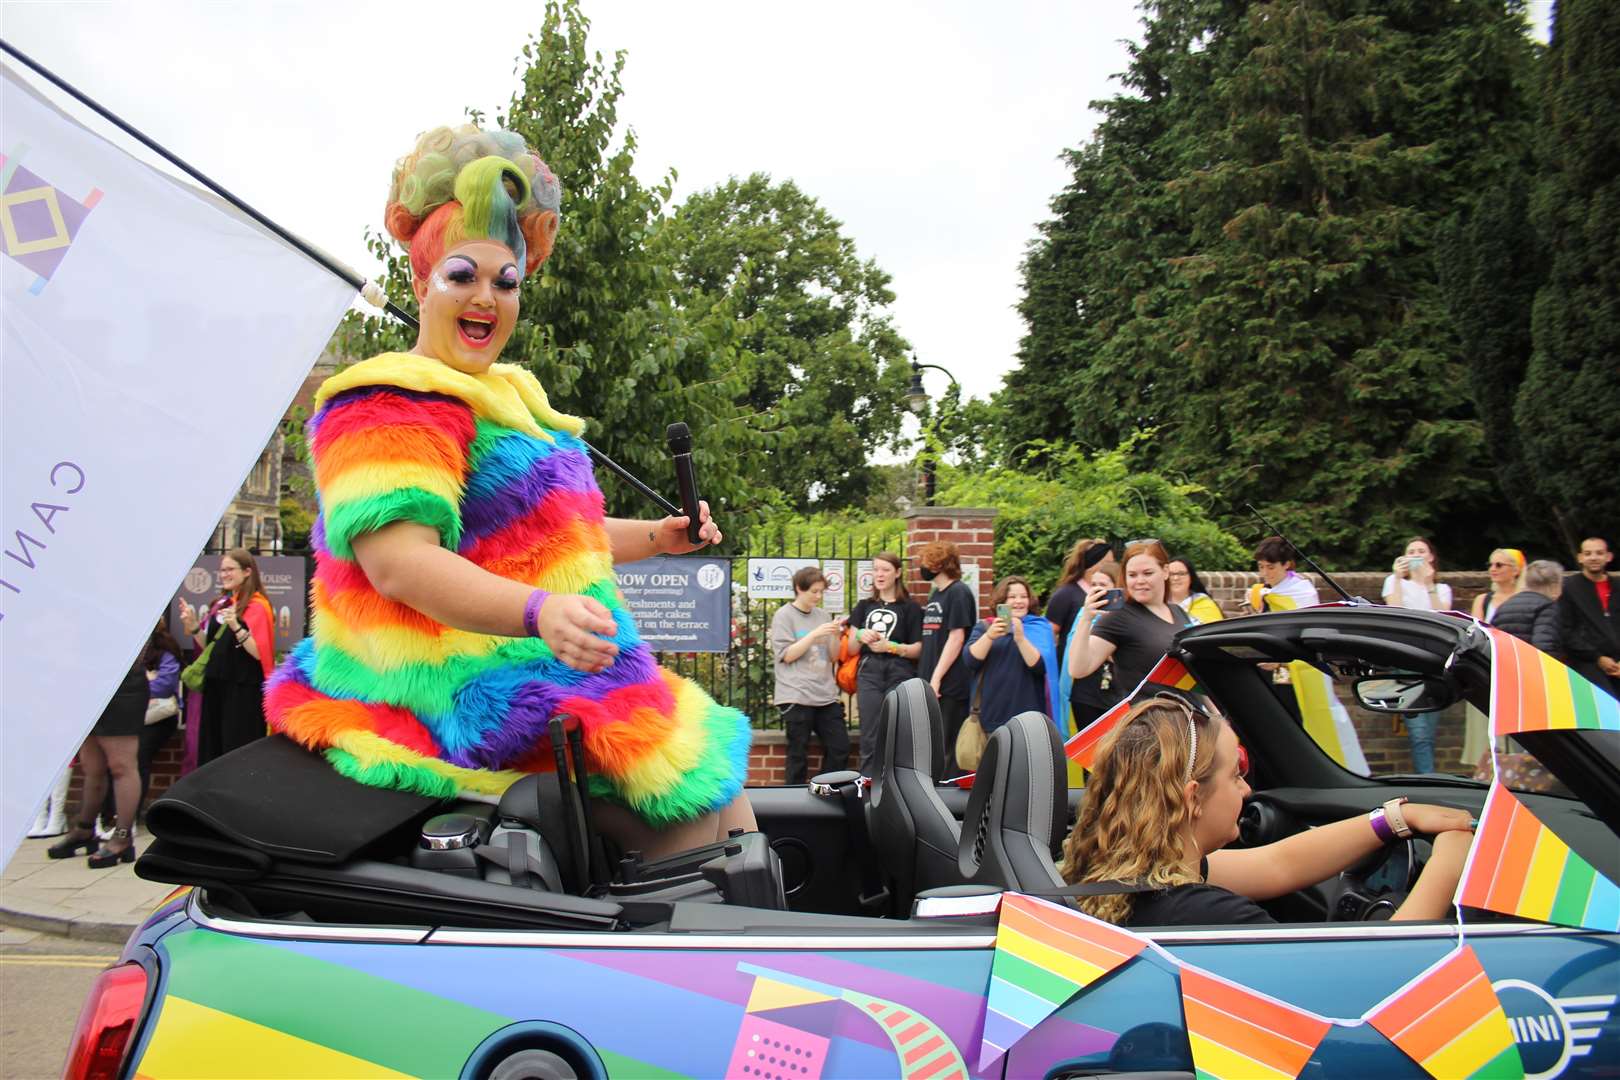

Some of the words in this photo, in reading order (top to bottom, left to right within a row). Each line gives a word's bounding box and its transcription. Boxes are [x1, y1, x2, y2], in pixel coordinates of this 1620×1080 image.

[616, 574, 647, 586] NOW
[651, 573, 689, 586] OPEN
[678, 599, 696, 609] and
[665, 609, 692, 619] cakes
[659, 619, 674, 629] the
[676, 620, 709, 629] terrace
